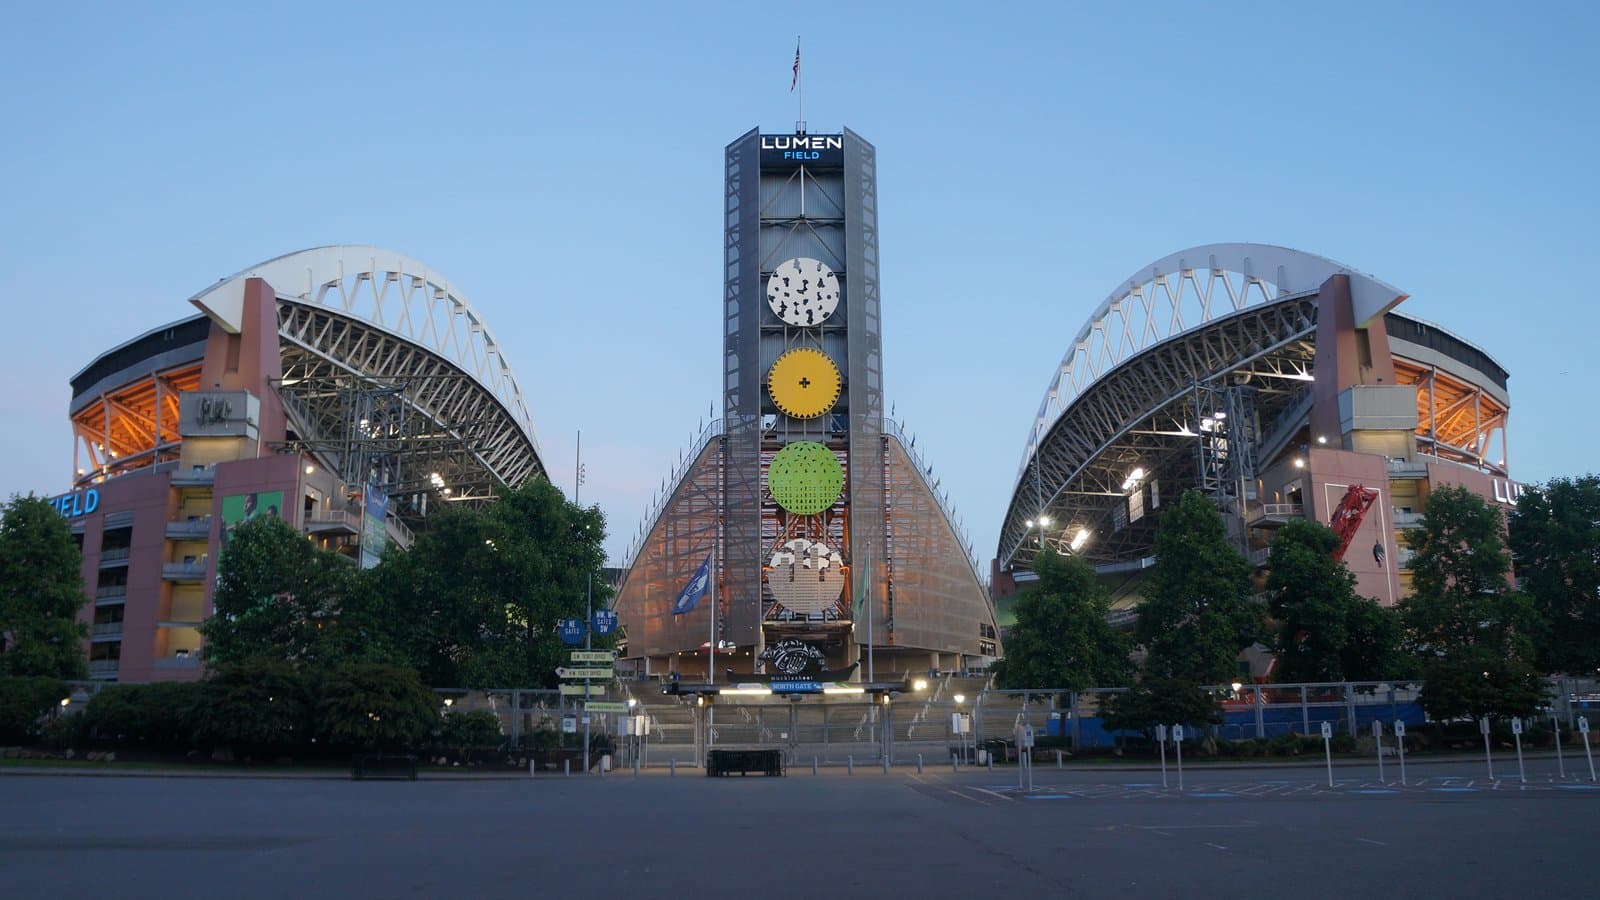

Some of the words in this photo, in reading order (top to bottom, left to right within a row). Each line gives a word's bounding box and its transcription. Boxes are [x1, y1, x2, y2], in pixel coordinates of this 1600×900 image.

[761, 137, 842, 149] LUMEN
[784, 151, 820, 160] FIELD
[48, 489, 99, 519] IELD
